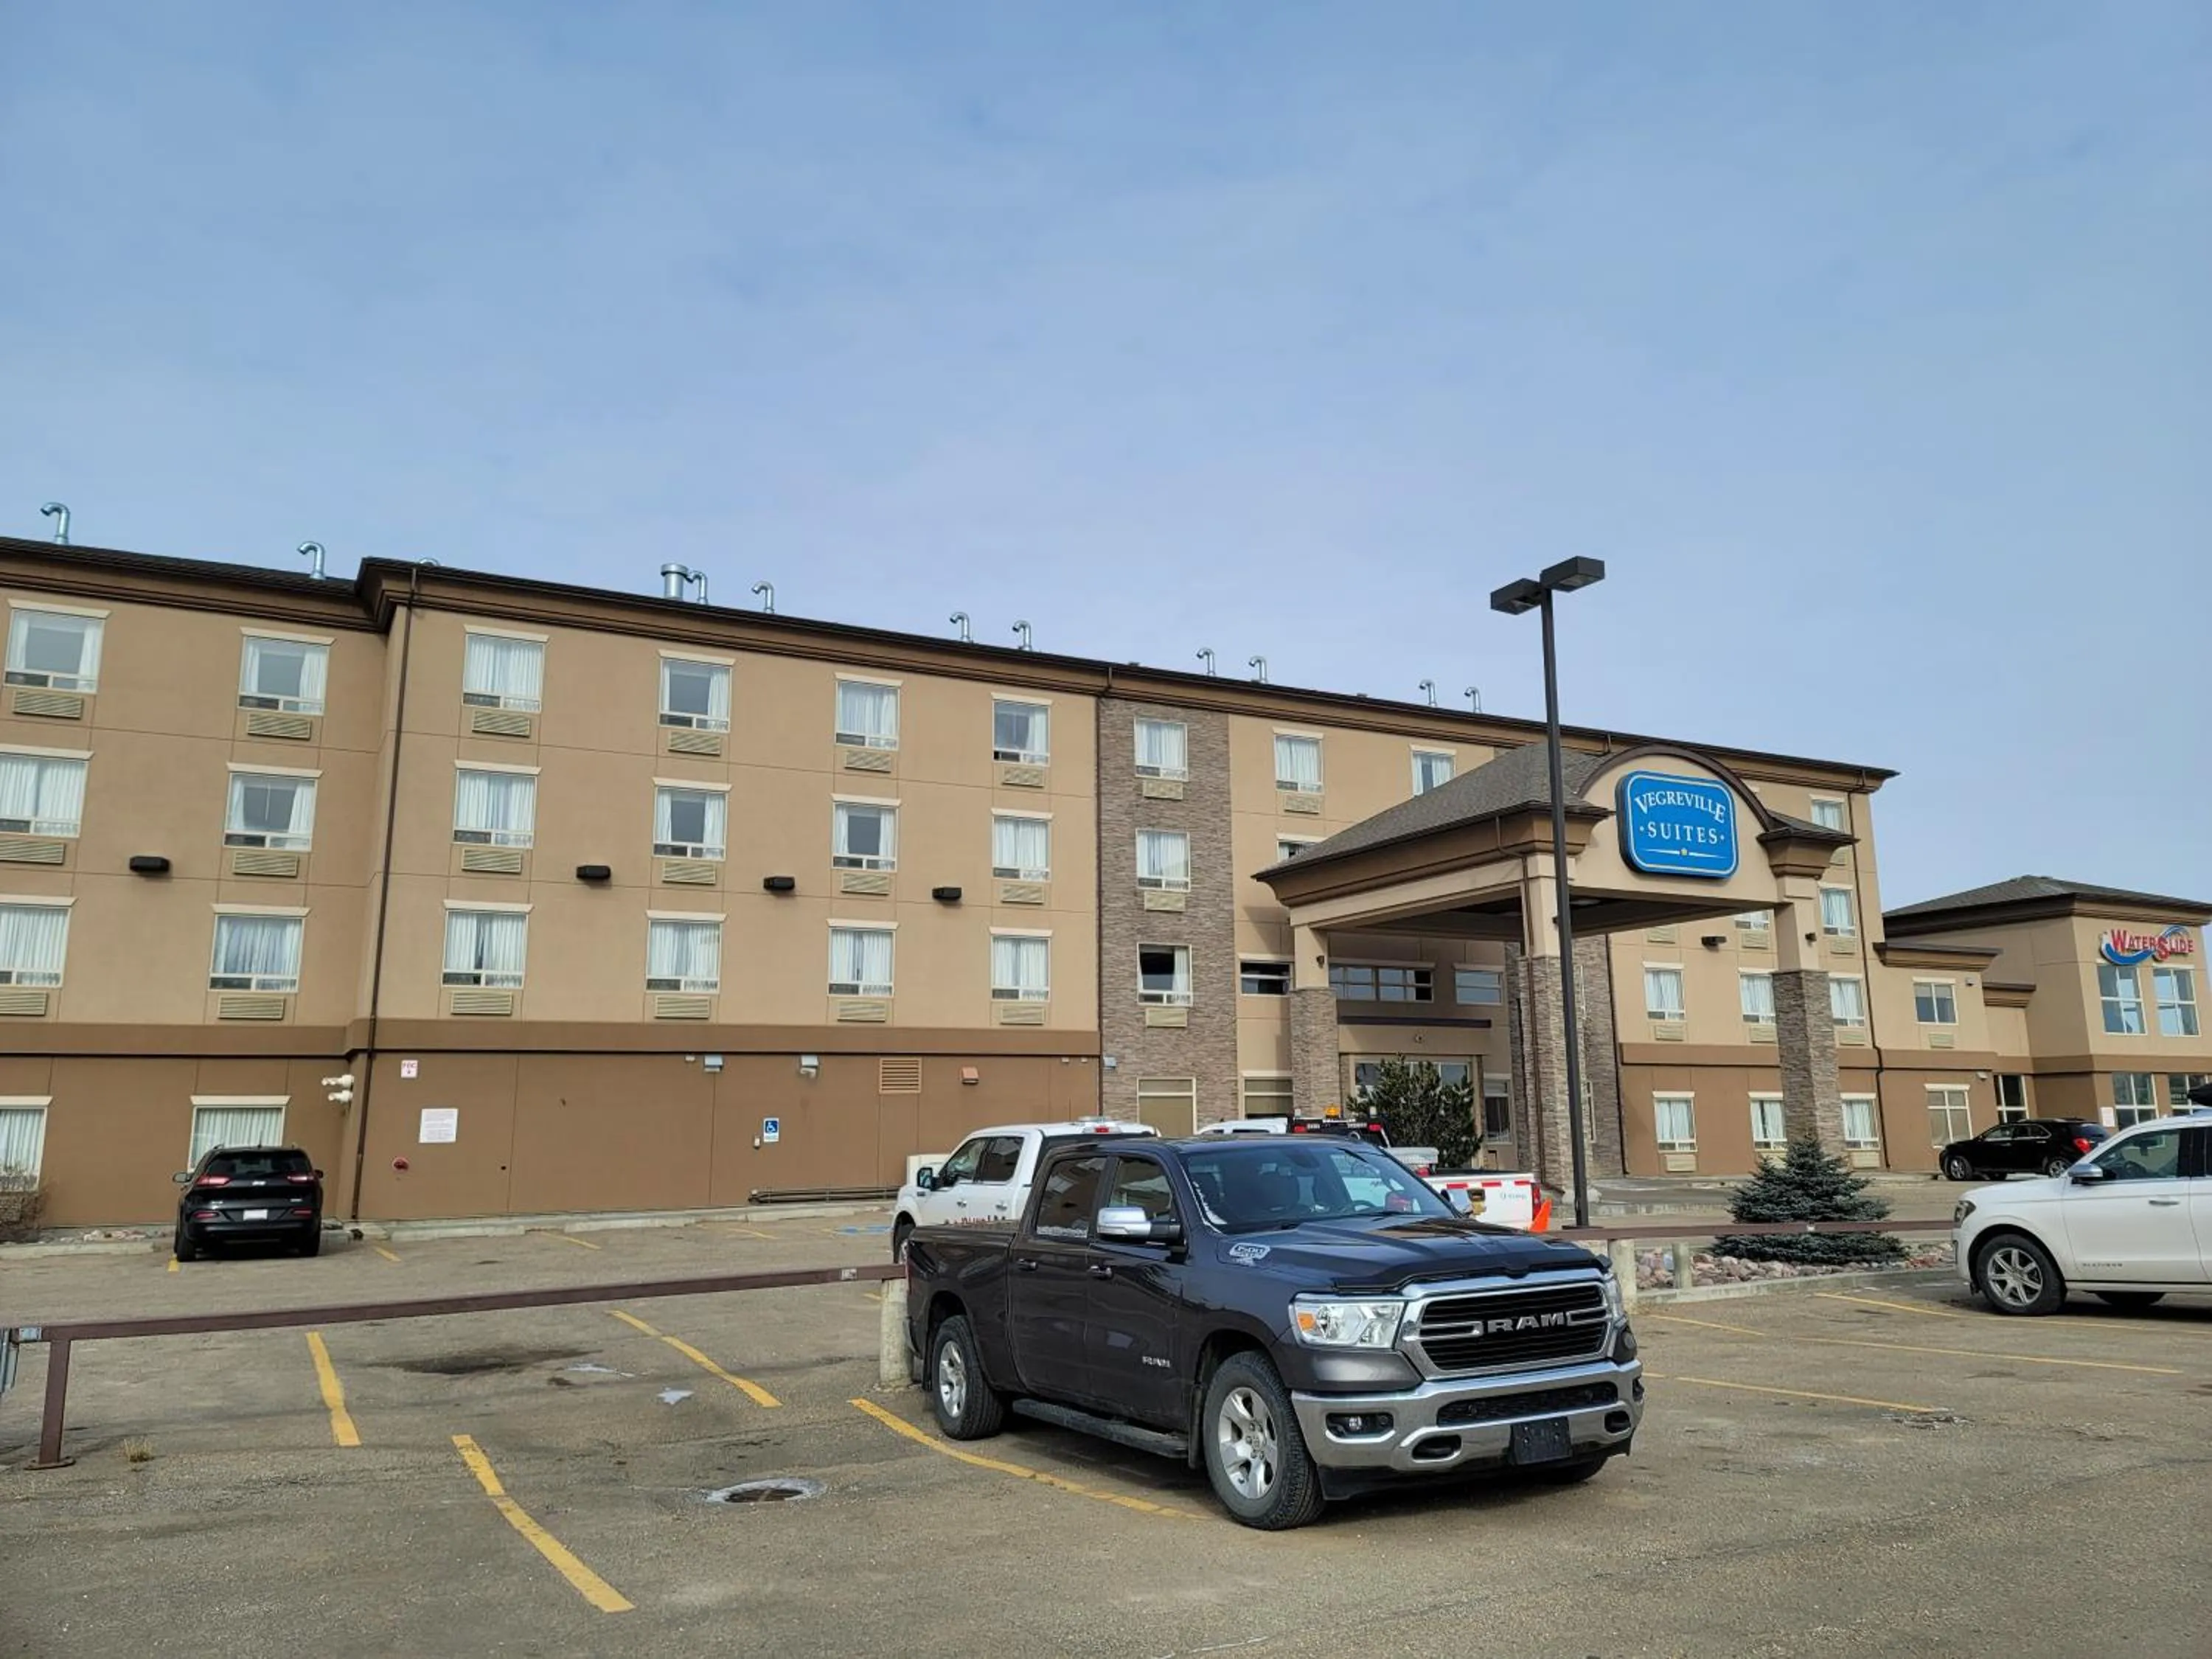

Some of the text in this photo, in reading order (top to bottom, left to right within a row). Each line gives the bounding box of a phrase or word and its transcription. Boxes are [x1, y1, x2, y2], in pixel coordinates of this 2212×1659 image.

[1635, 790, 1726, 824] VEGREVILLE
[1648, 821, 1717, 844] SUITES
[1487, 1312, 1565, 1333] RAM
